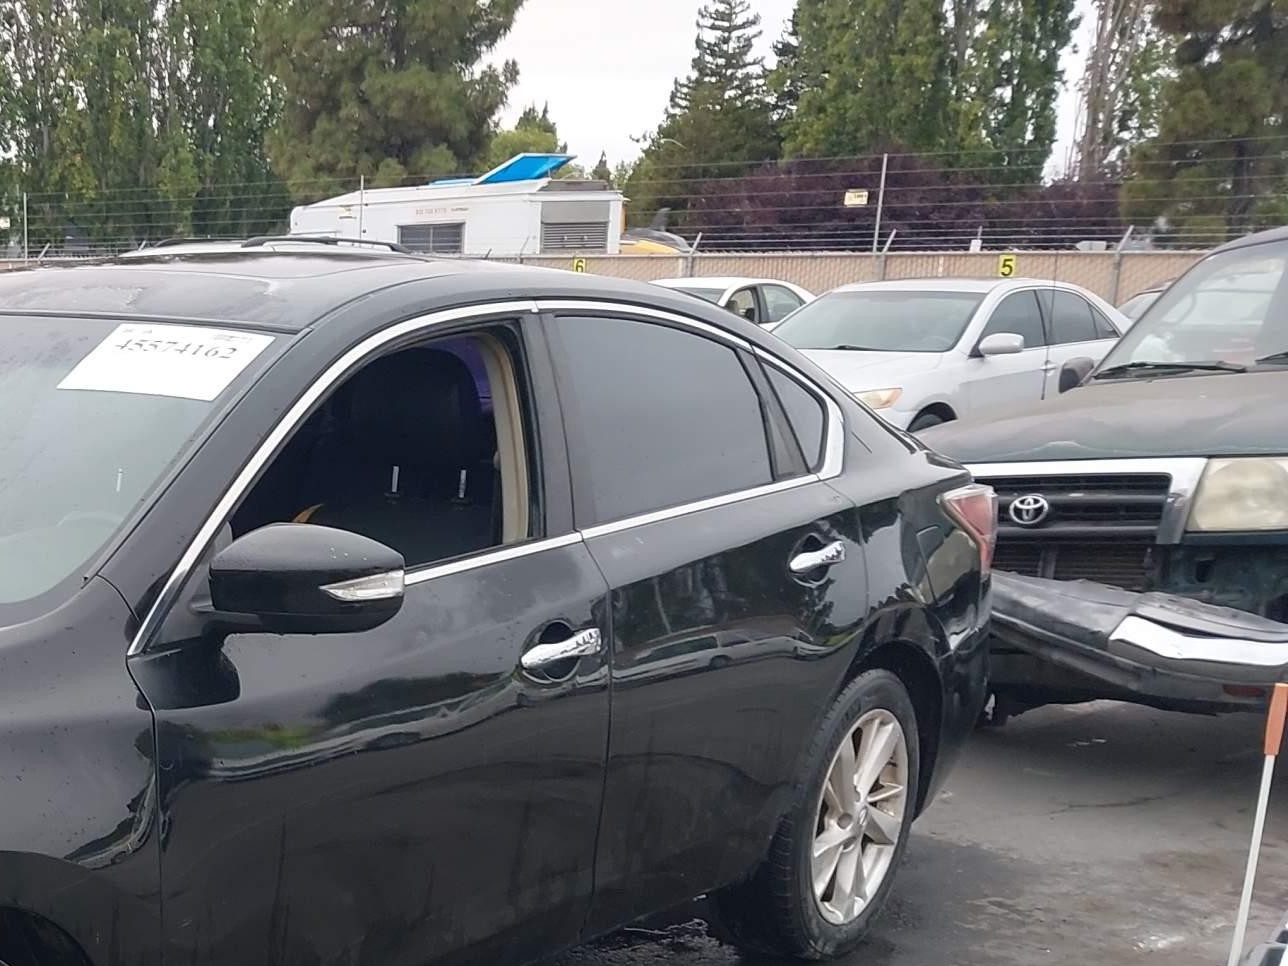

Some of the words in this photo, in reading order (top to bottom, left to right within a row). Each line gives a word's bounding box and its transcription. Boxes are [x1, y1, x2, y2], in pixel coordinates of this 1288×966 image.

[575, 259, 584, 273] 6
[1001, 258, 1013, 277] 5
[115, 338, 237, 359] 45574162
